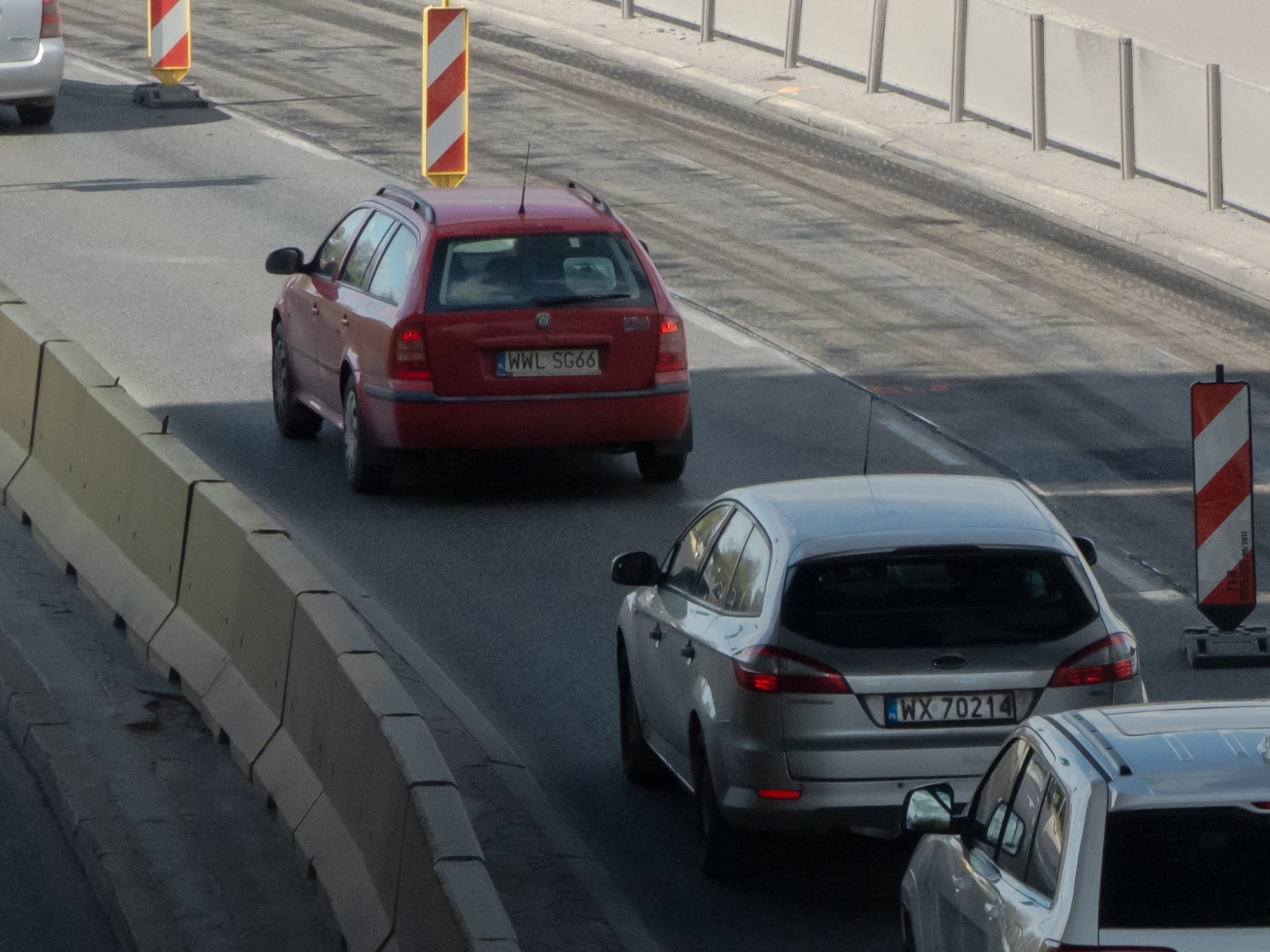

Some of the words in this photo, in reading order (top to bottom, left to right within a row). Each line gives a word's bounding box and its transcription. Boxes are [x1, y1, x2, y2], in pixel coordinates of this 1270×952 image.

[508, 352, 545, 370] WWL
[552, 350, 596, 369] SG66
[901, 698, 933, 720] WX
[941, 695, 1012, 719] 70214
